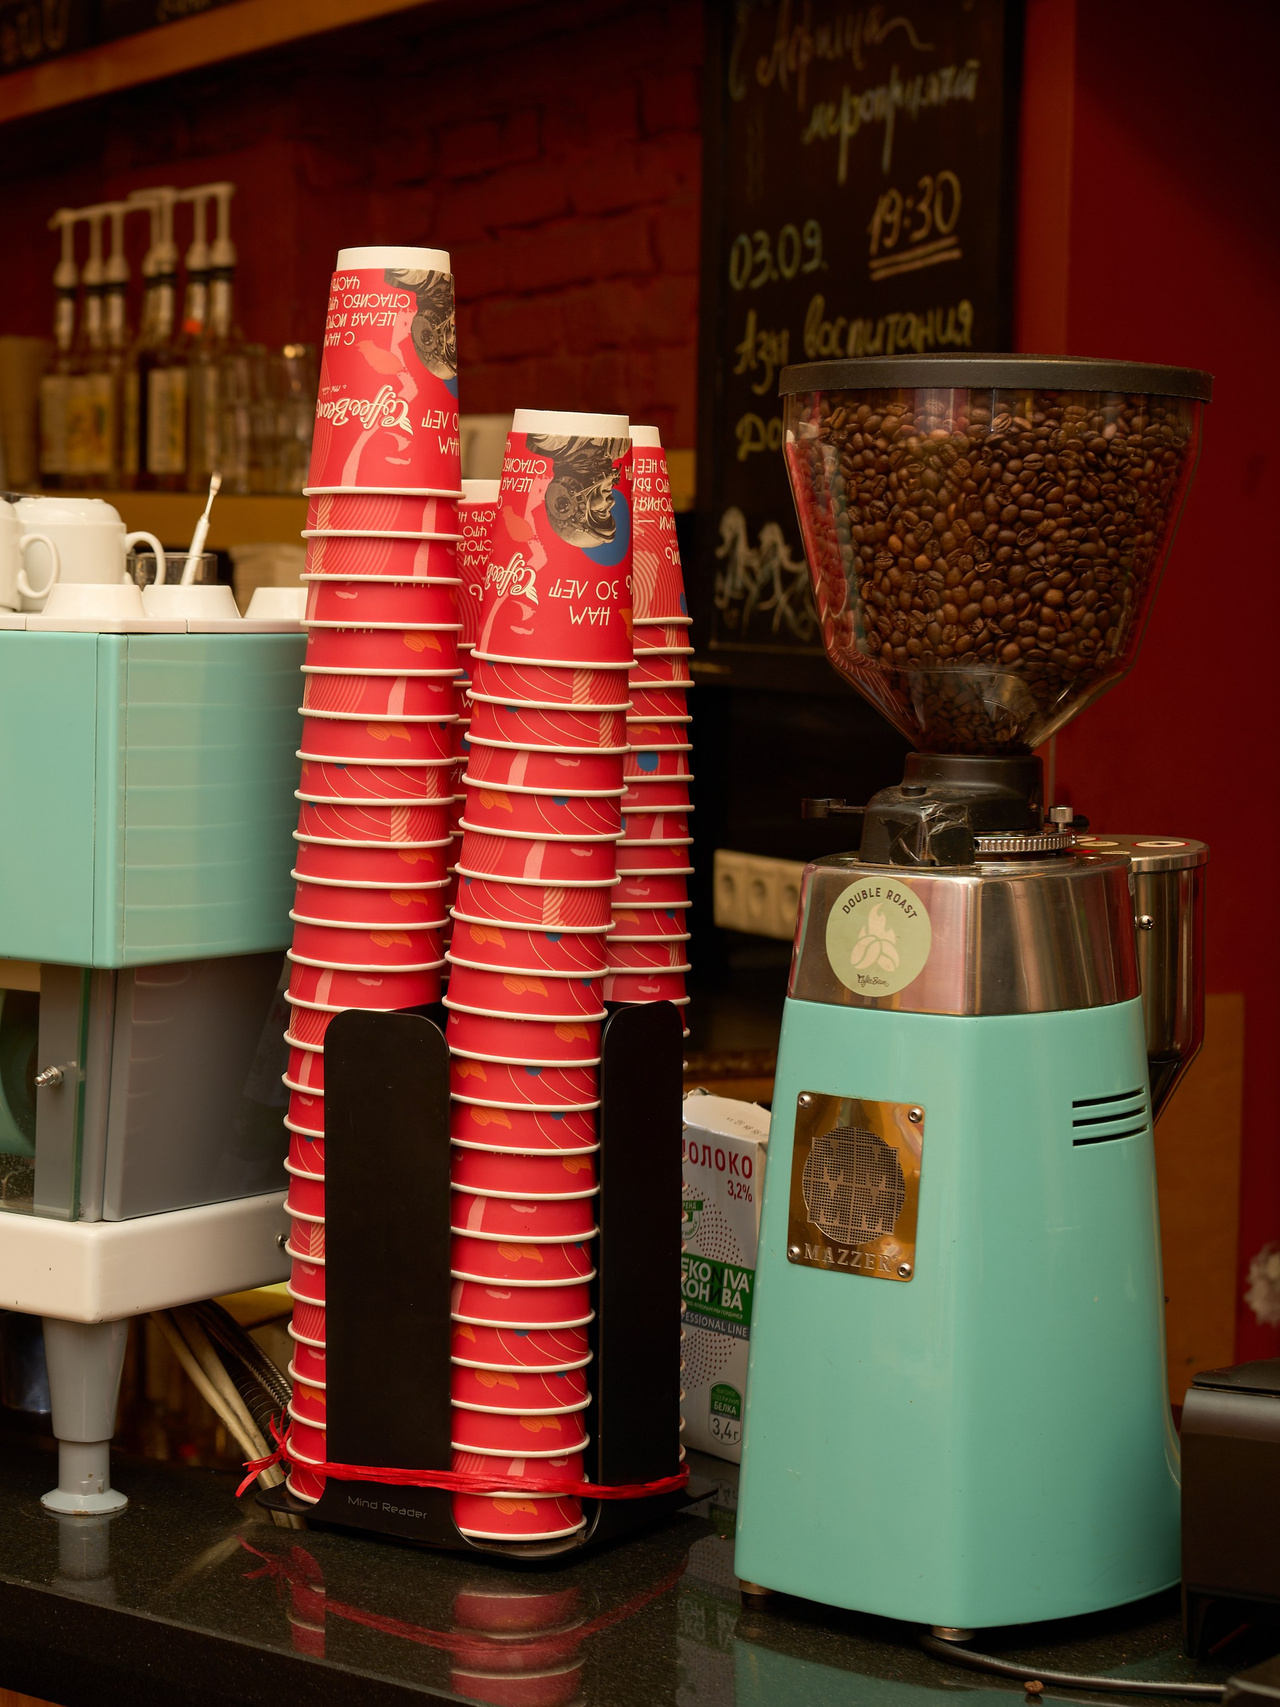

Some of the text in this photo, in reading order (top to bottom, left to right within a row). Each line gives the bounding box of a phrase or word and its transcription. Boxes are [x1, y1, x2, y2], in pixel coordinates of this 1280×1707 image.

[867, 170, 962, 256] 19:30
[351, 310, 398, 327] ЦЕЛАЯ
[421, 409, 450, 430] ЛЕТ
[548, 578, 589, 600] ЛЕТ
[596, 579, 619, 601] 30
[569, 605, 611, 626] НАМ
[842, 887, 918, 919] DOUBLE ROAST
[727, 1179, 753, 1203] 3,2%
[803, 1242, 892, 1273] MAZZER
[727, 1322, 748, 1337] LINE
[713, 1400, 737, 1416] БЕЛКА
[347, 1495, 428, 1519] Mind Reader
